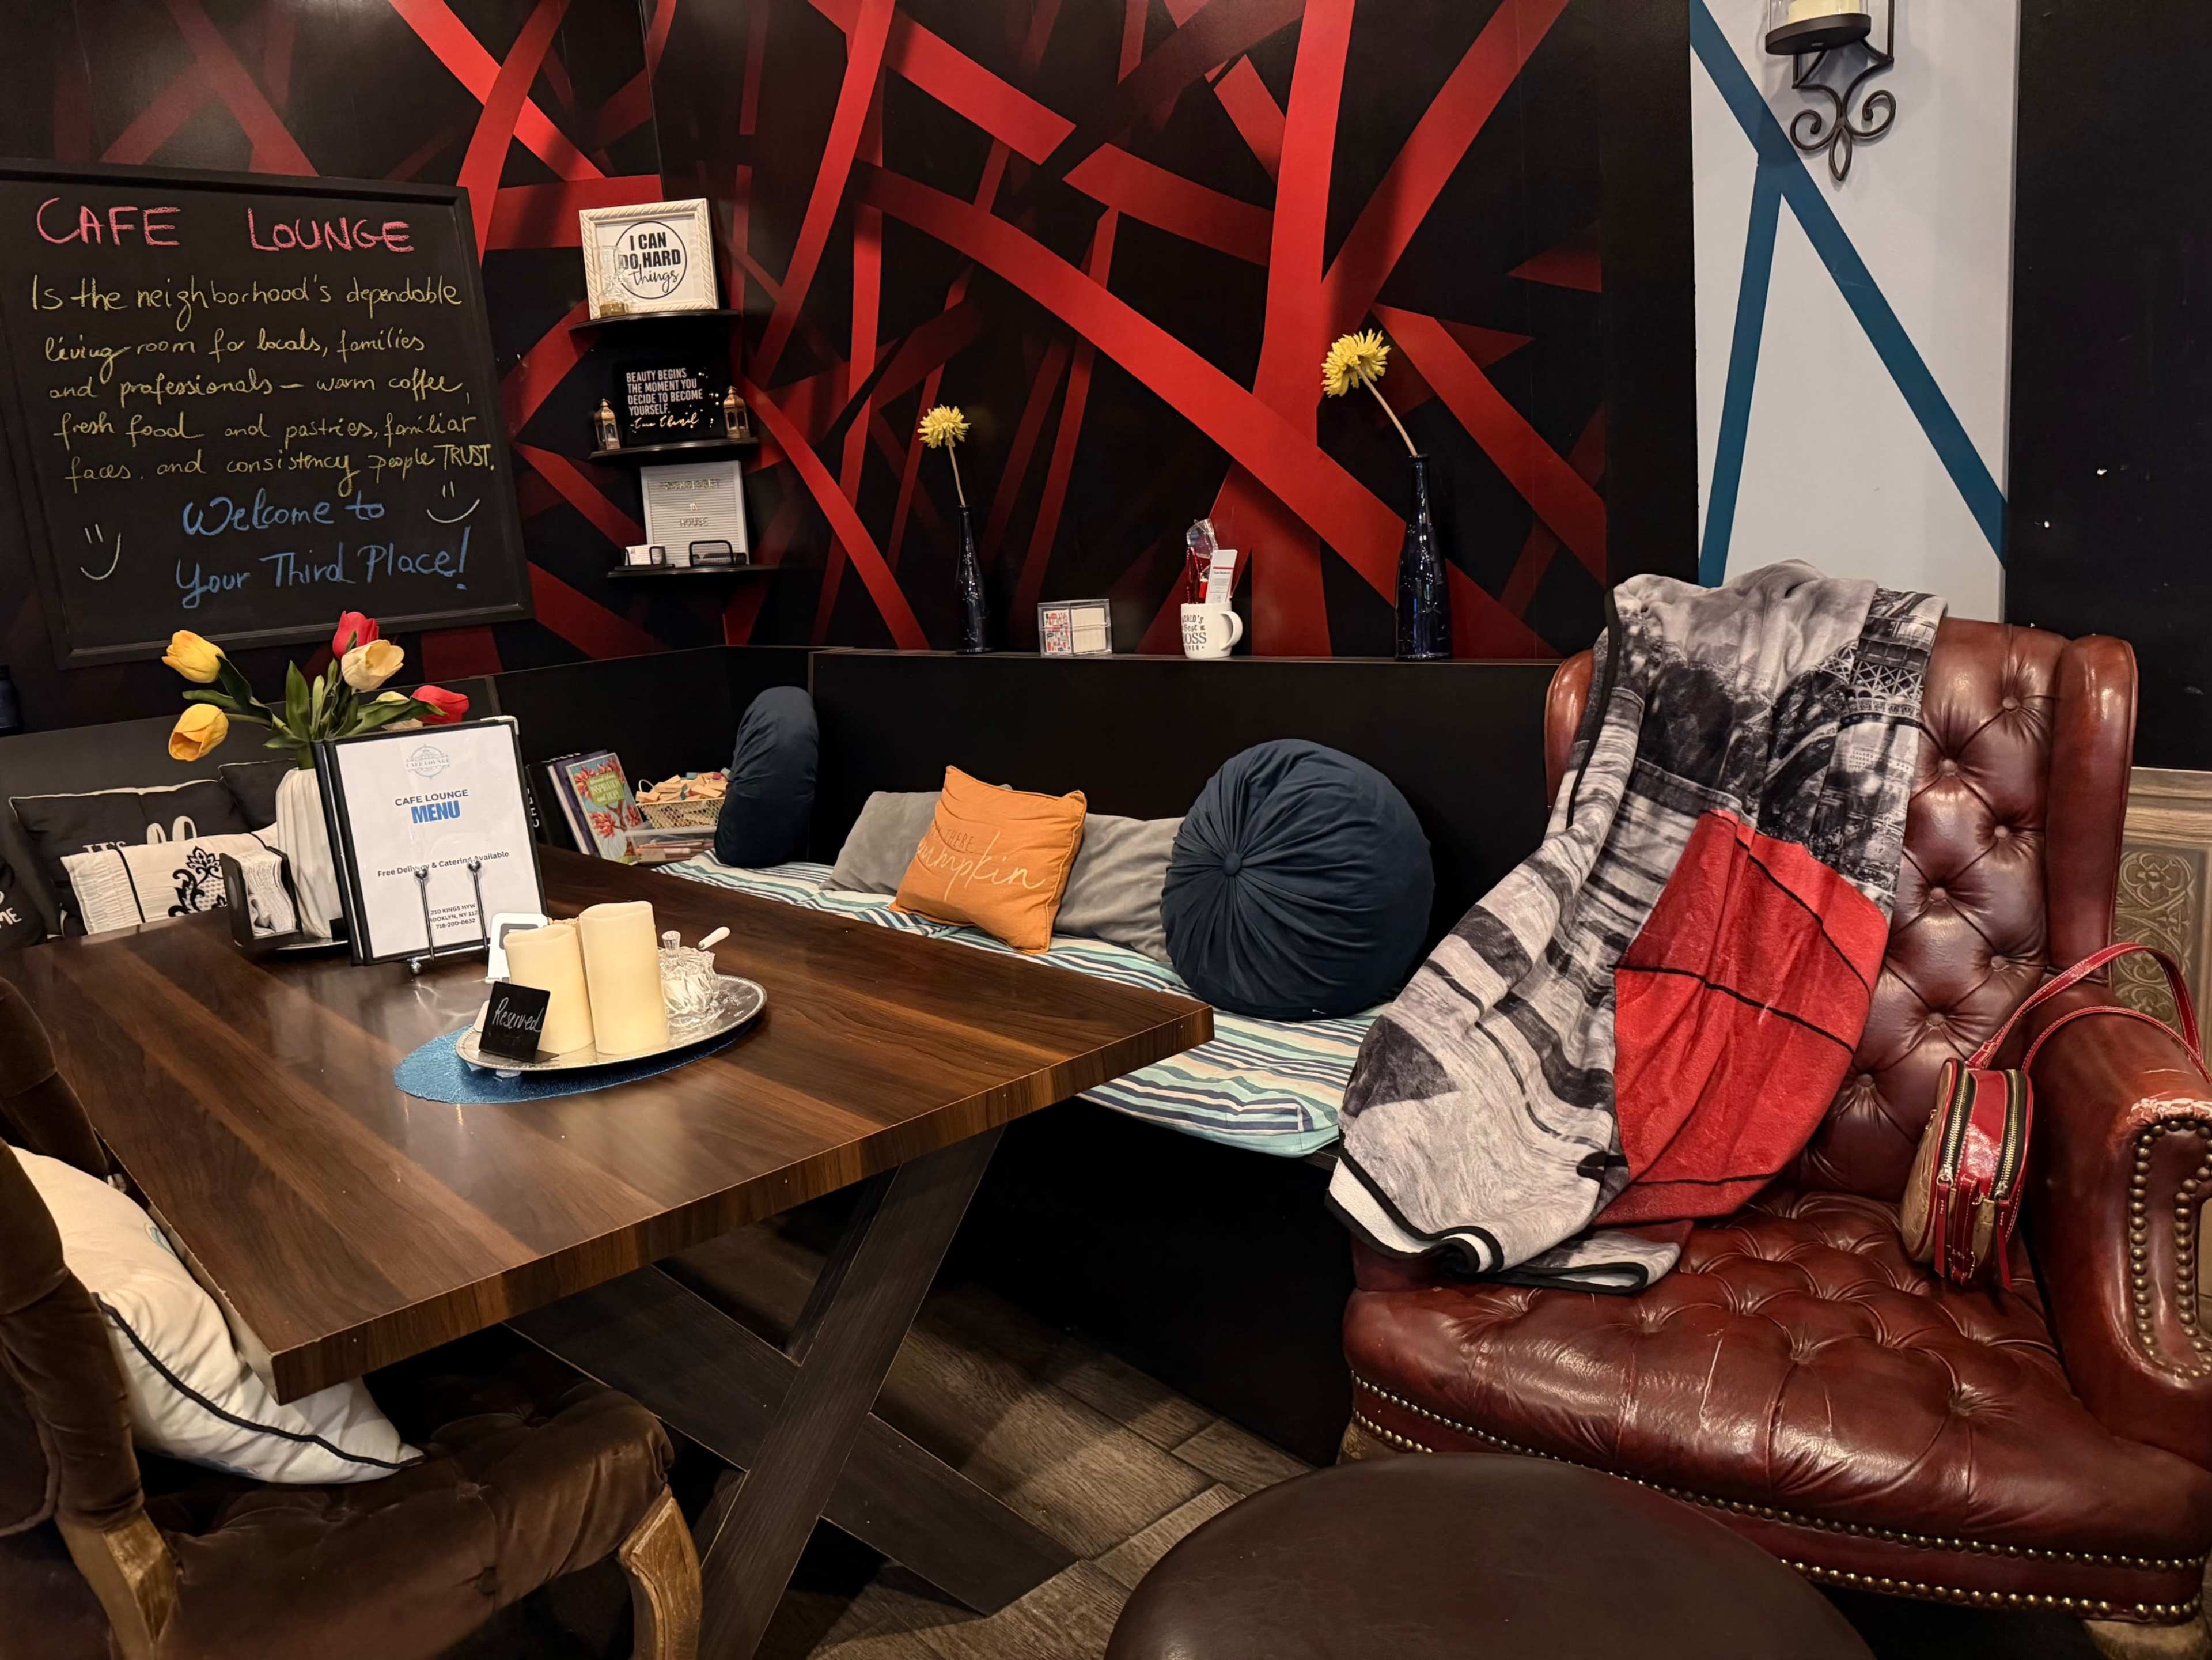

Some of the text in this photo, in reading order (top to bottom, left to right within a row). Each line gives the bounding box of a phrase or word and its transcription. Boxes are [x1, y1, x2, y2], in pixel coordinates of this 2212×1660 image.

[37, 197, 414, 252] CAFE LOUNGE
[630, 232, 666, 251] I CAN
[618, 249, 681, 269] DO HARD
[628, 264, 679, 293] things
[32, 274, 462, 331] Is the neighborhood's dependable
[46, 327, 425, 384] living room for locals, families
[50, 377, 97, 398] and
[120, 368, 272, 409] professionals
[317, 377, 375, 391] warm
[626, 368, 687, 383] BEAUTY BEGINS
[627, 378, 697, 394] THE MOMENT YOU
[628, 389, 703, 405] DECIDE TO BECOME
[629, 404, 671, 416] YOURSELF.
[53, 411, 476, 451] fresh food and pastries, familiar
[157, 449, 206, 474] and
[226, 449, 360, 497] consistency
[368, 448, 435, 483] people
[434, 444, 495, 471] TRUST.
[183, 488, 385, 535] Welcome to
[176, 527, 470, 608] Your Third Place!
[1183, 632, 1207, 644] OSS
[395, 789, 469, 806] CAFE LOUNGE
[411, 800, 460, 823] MENU
[378, 869, 396, 877] Free
[492, 997, 544, 1032] Reserved
